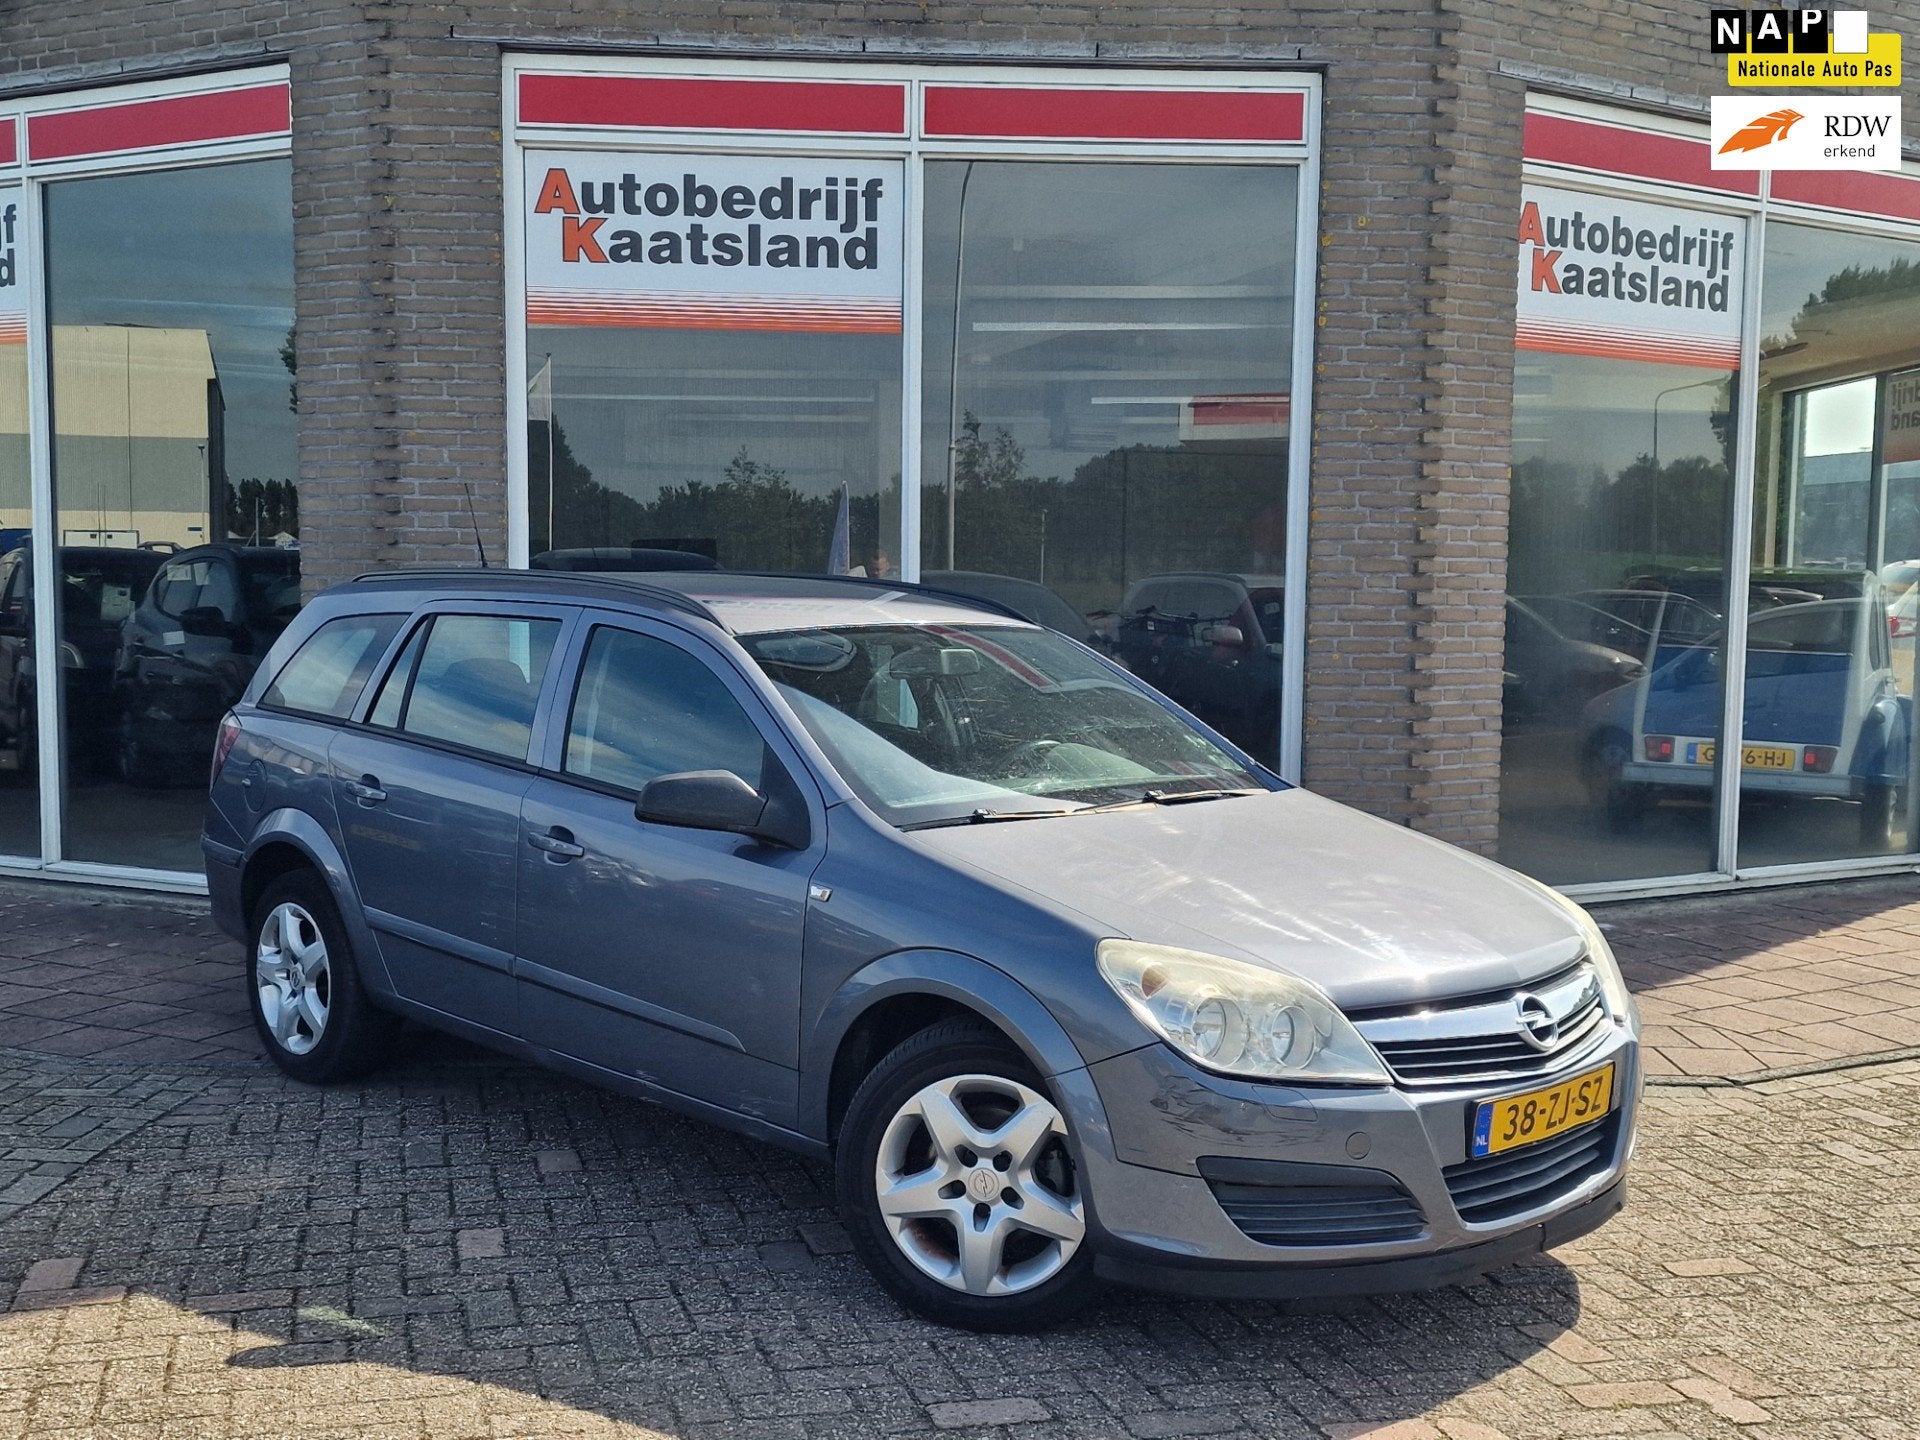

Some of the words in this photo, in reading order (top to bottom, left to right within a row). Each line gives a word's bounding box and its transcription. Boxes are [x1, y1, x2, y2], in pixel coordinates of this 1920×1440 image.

[534, 168, 883, 233] Autobedrijf
[562, 216, 878, 270] Kaatsland
[1519, 201, 1734, 279] Autobedrijf
[1531, 247, 1729, 313] Kaatsland
[1476, 1134, 1488, 1147] NL
[1503, 1075, 1604, 1141] 38-ZJ-SZ
